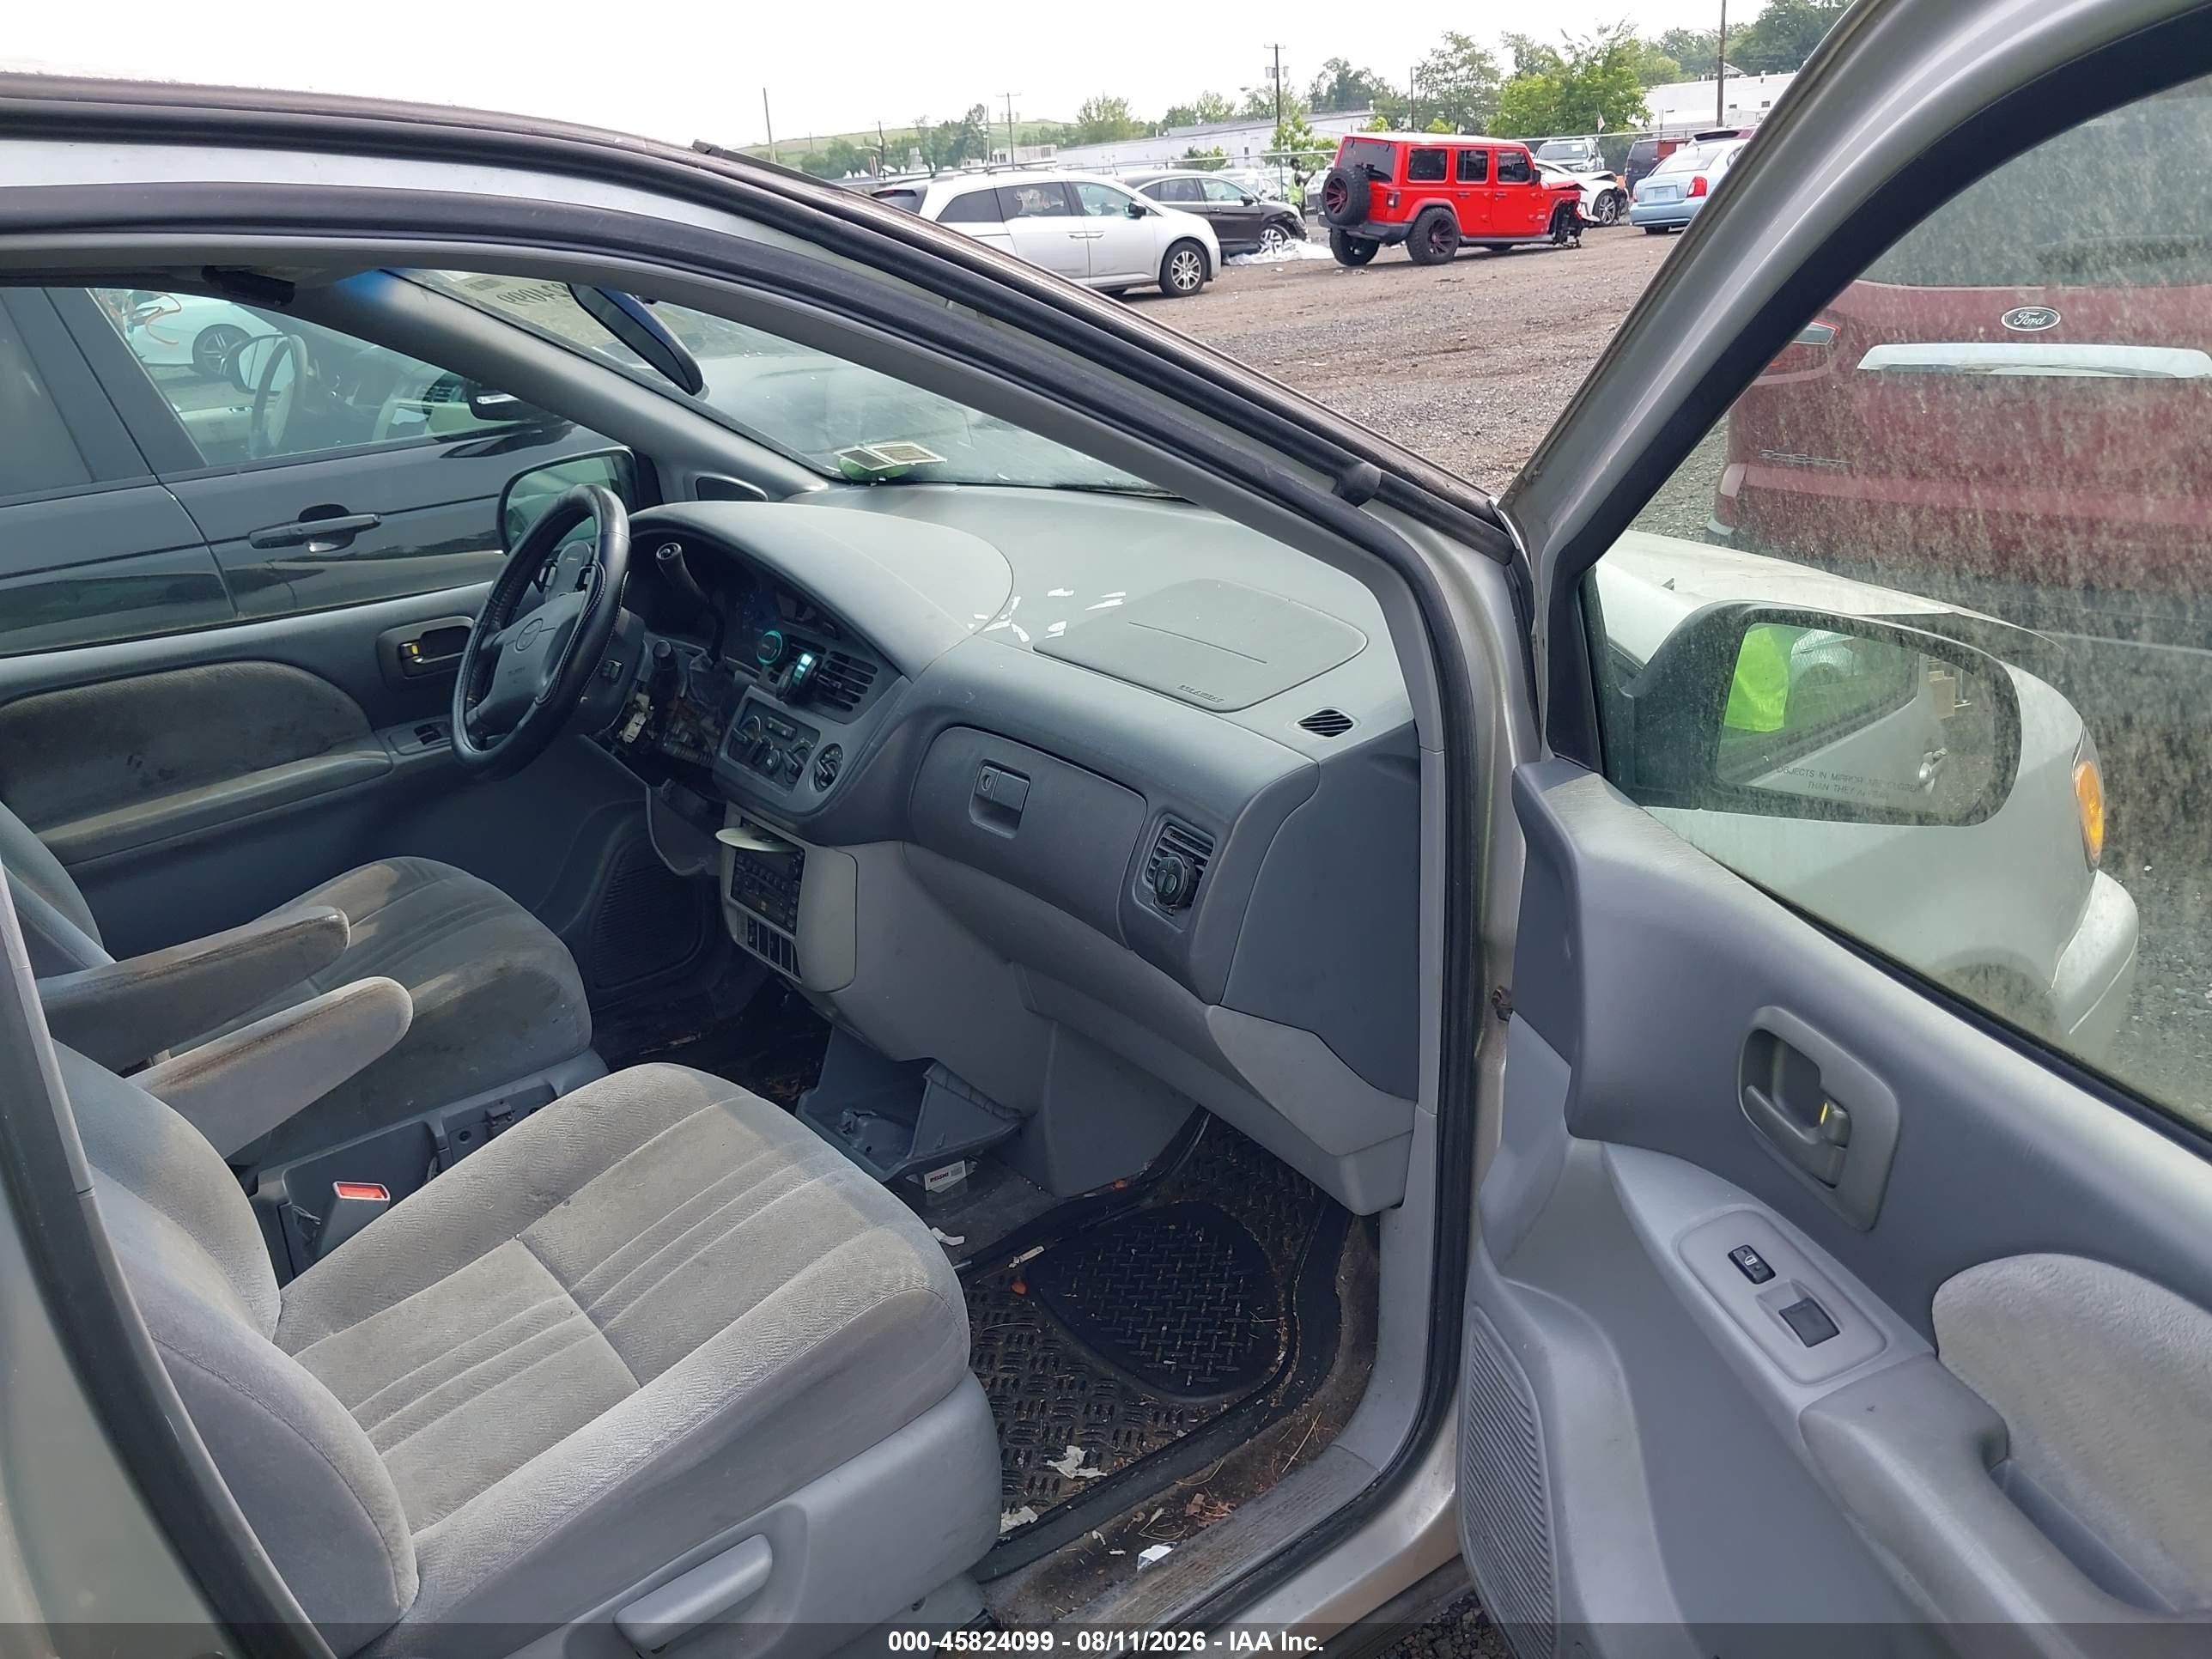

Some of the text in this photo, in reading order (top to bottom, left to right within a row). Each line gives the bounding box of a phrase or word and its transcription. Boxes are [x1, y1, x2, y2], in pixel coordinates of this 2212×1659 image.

[2013, 311, 2048, 325] Ford
[1777, 766, 1814, 778] OBJECTS
[1819, 771, 1827, 780] IN
